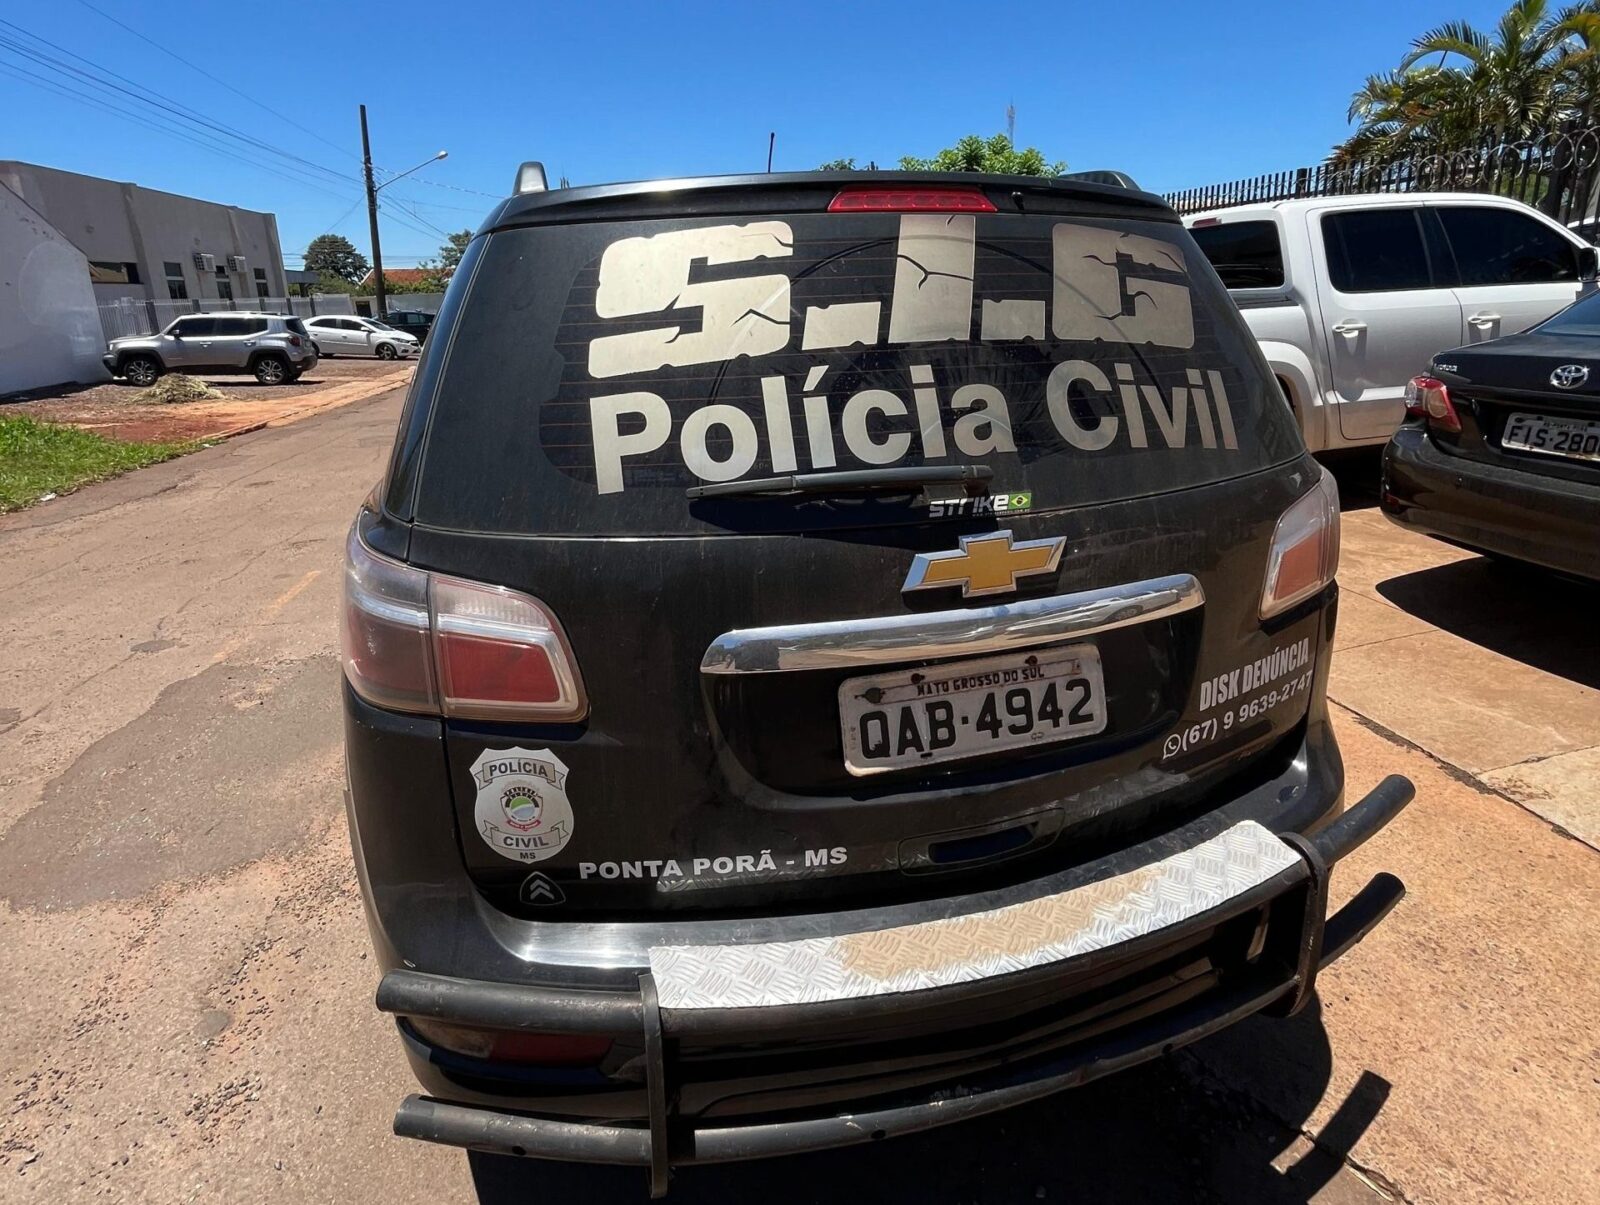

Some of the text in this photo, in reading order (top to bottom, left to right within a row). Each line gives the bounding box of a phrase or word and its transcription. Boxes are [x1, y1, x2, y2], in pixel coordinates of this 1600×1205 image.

[590, 360, 1239, 494] Polícia Civil
[917, 667, 1044, 697] MATO GROSSO DO SUL
[1200, 637, 1309, 711] DISK DENÚNCIA
[1182, 669, 1313, 751] (67) 9 9639-2747
[489, 759, 548, 777] POLÍCIA
[503, 836, 549, 848] CIVIL
[520, 852, 536, 860] MS
[579, 859, 683, 879] PONTA
[693, 850, 776, 875] PORÃ
[805, 847, 848, 867] MS
